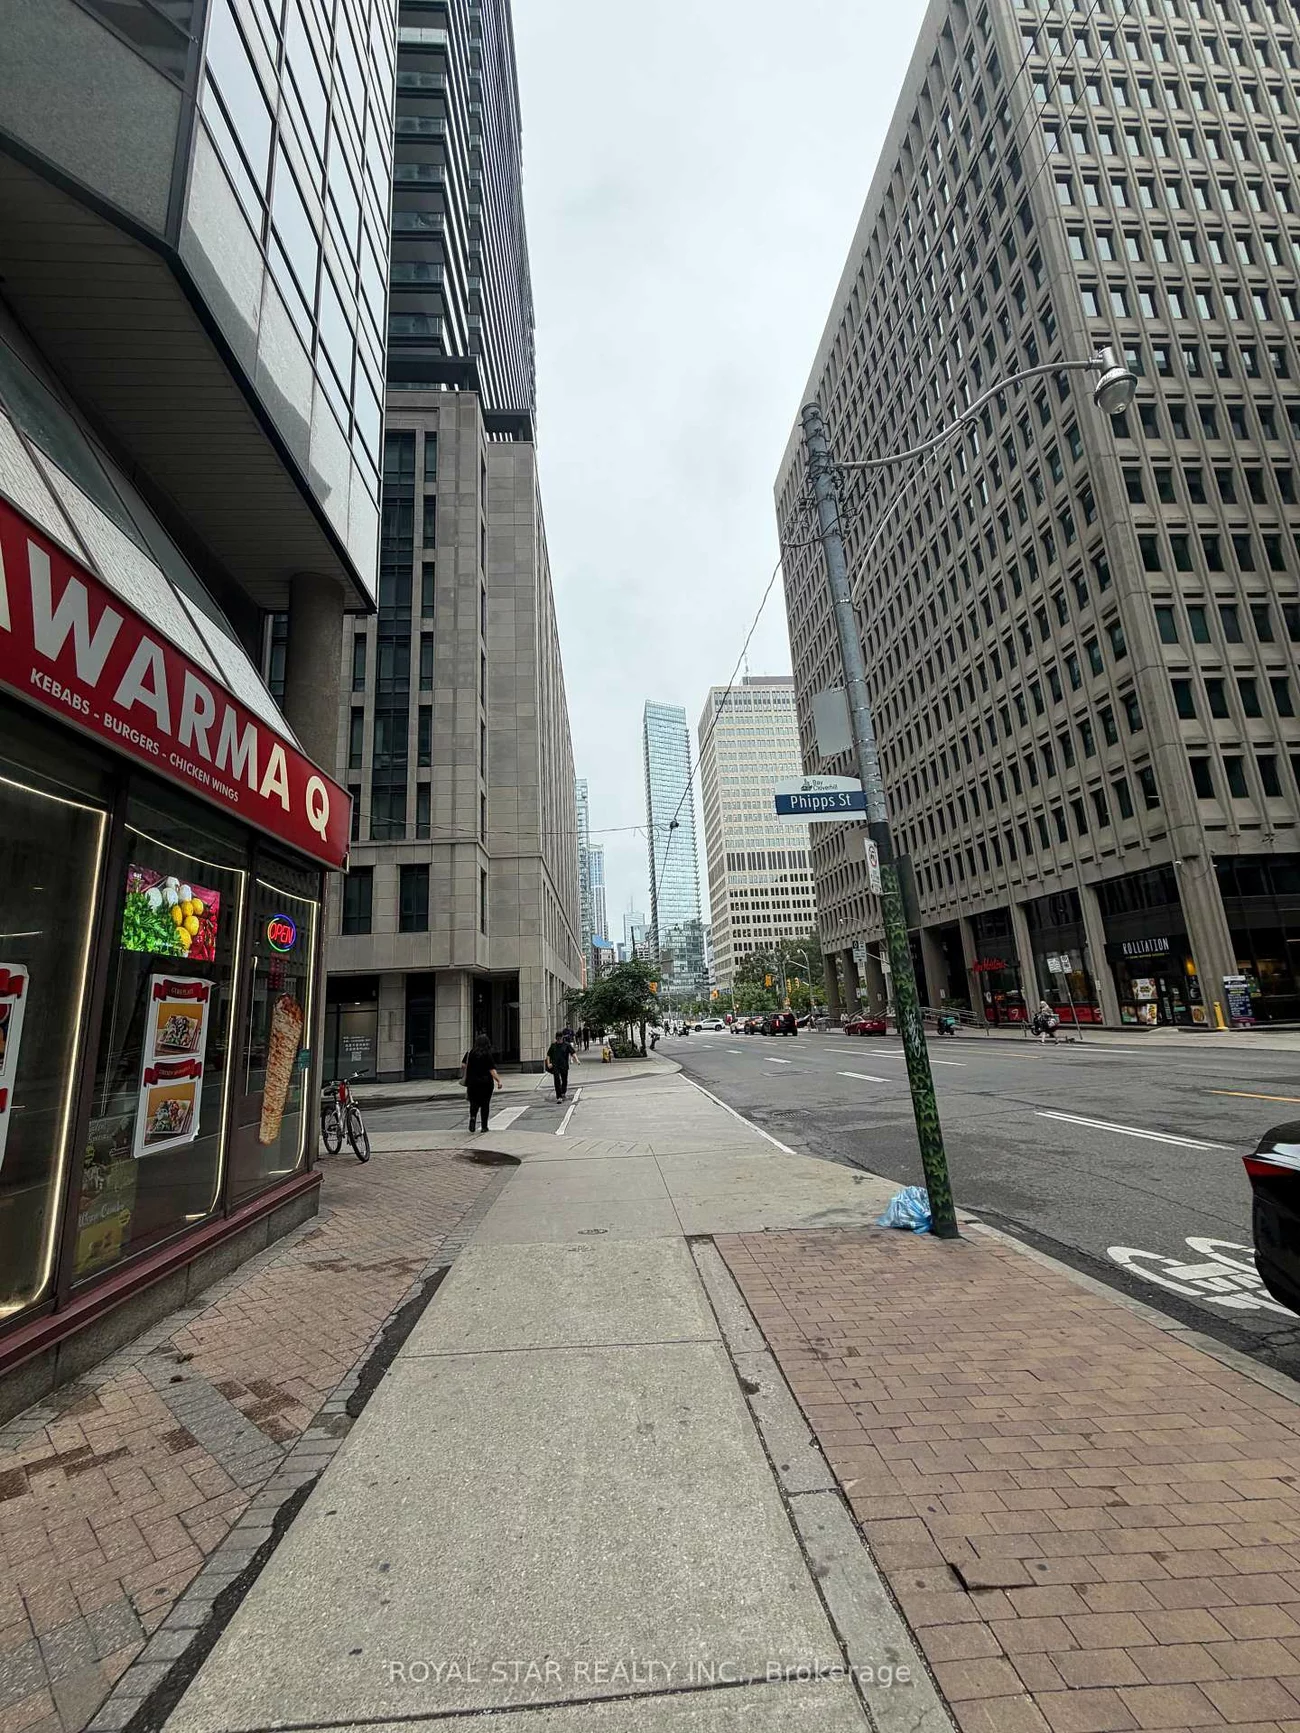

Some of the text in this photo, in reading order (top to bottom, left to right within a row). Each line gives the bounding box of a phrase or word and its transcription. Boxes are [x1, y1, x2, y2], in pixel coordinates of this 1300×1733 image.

[30, 667, 90, 717] KEBABS
[103, 713, 160, 756] BURGERS
[169, 752, 211, 786] CHICKEN
[212, 776, 240, 803] WINGS
[305, 775, 330, 843] Q
[790, 792, 852, 811] Phipps St
[269, 922, 294, 944] OPEN
